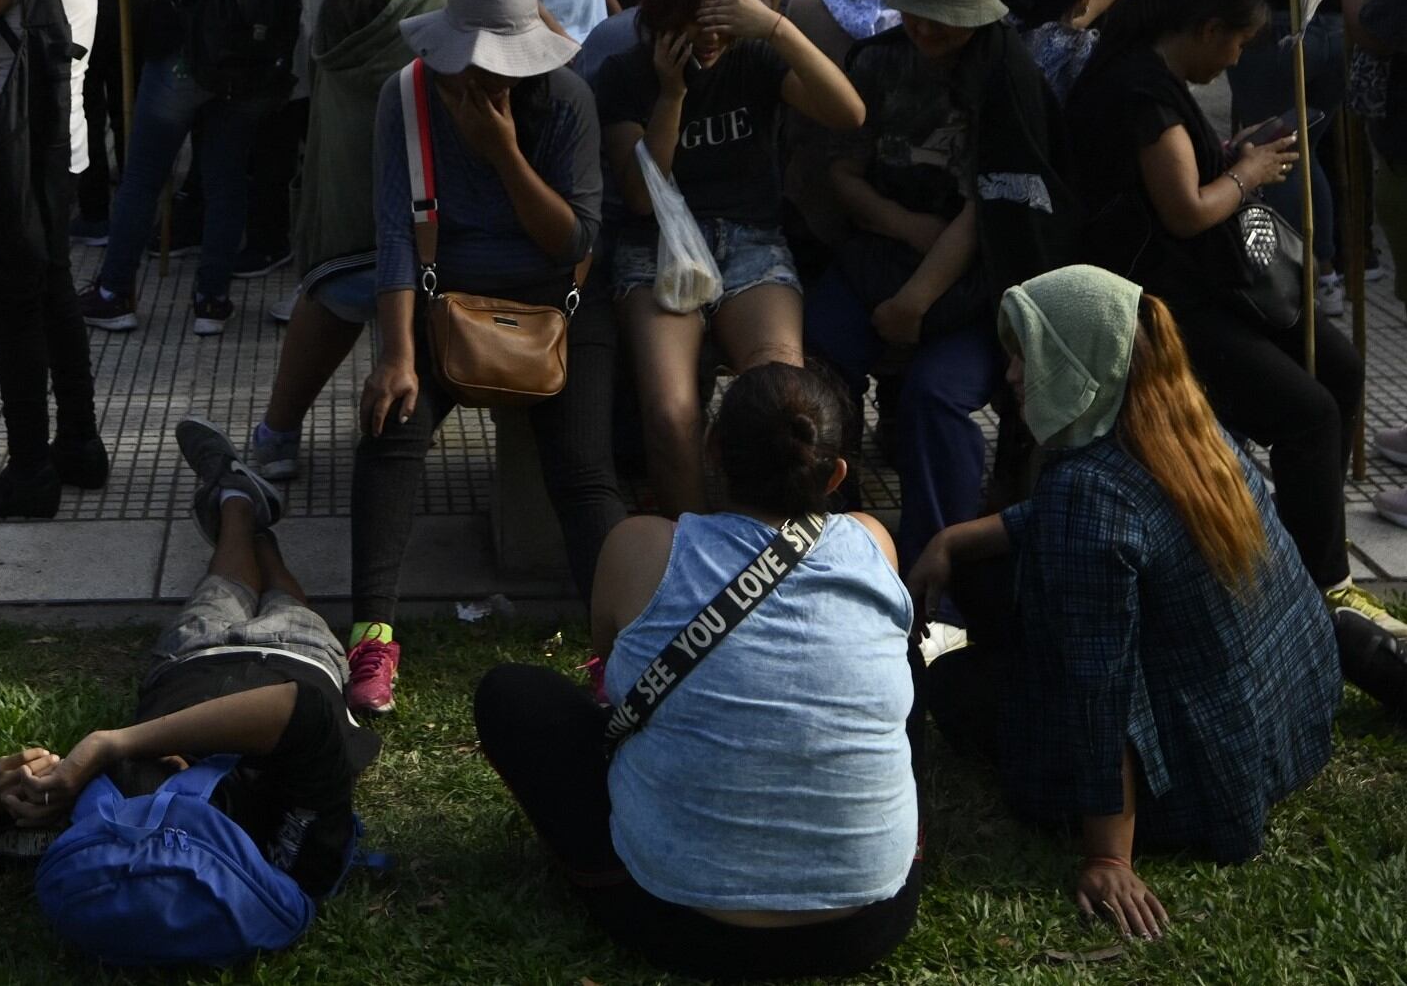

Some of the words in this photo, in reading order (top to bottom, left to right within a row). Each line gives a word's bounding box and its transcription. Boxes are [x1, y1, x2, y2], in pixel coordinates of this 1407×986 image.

[681, 106, 753, 150] GUE
[636, 657, 678, 705] SEE
[672, 604, 728, 660] YOU
[725, 546, 788, 611] LOVE
